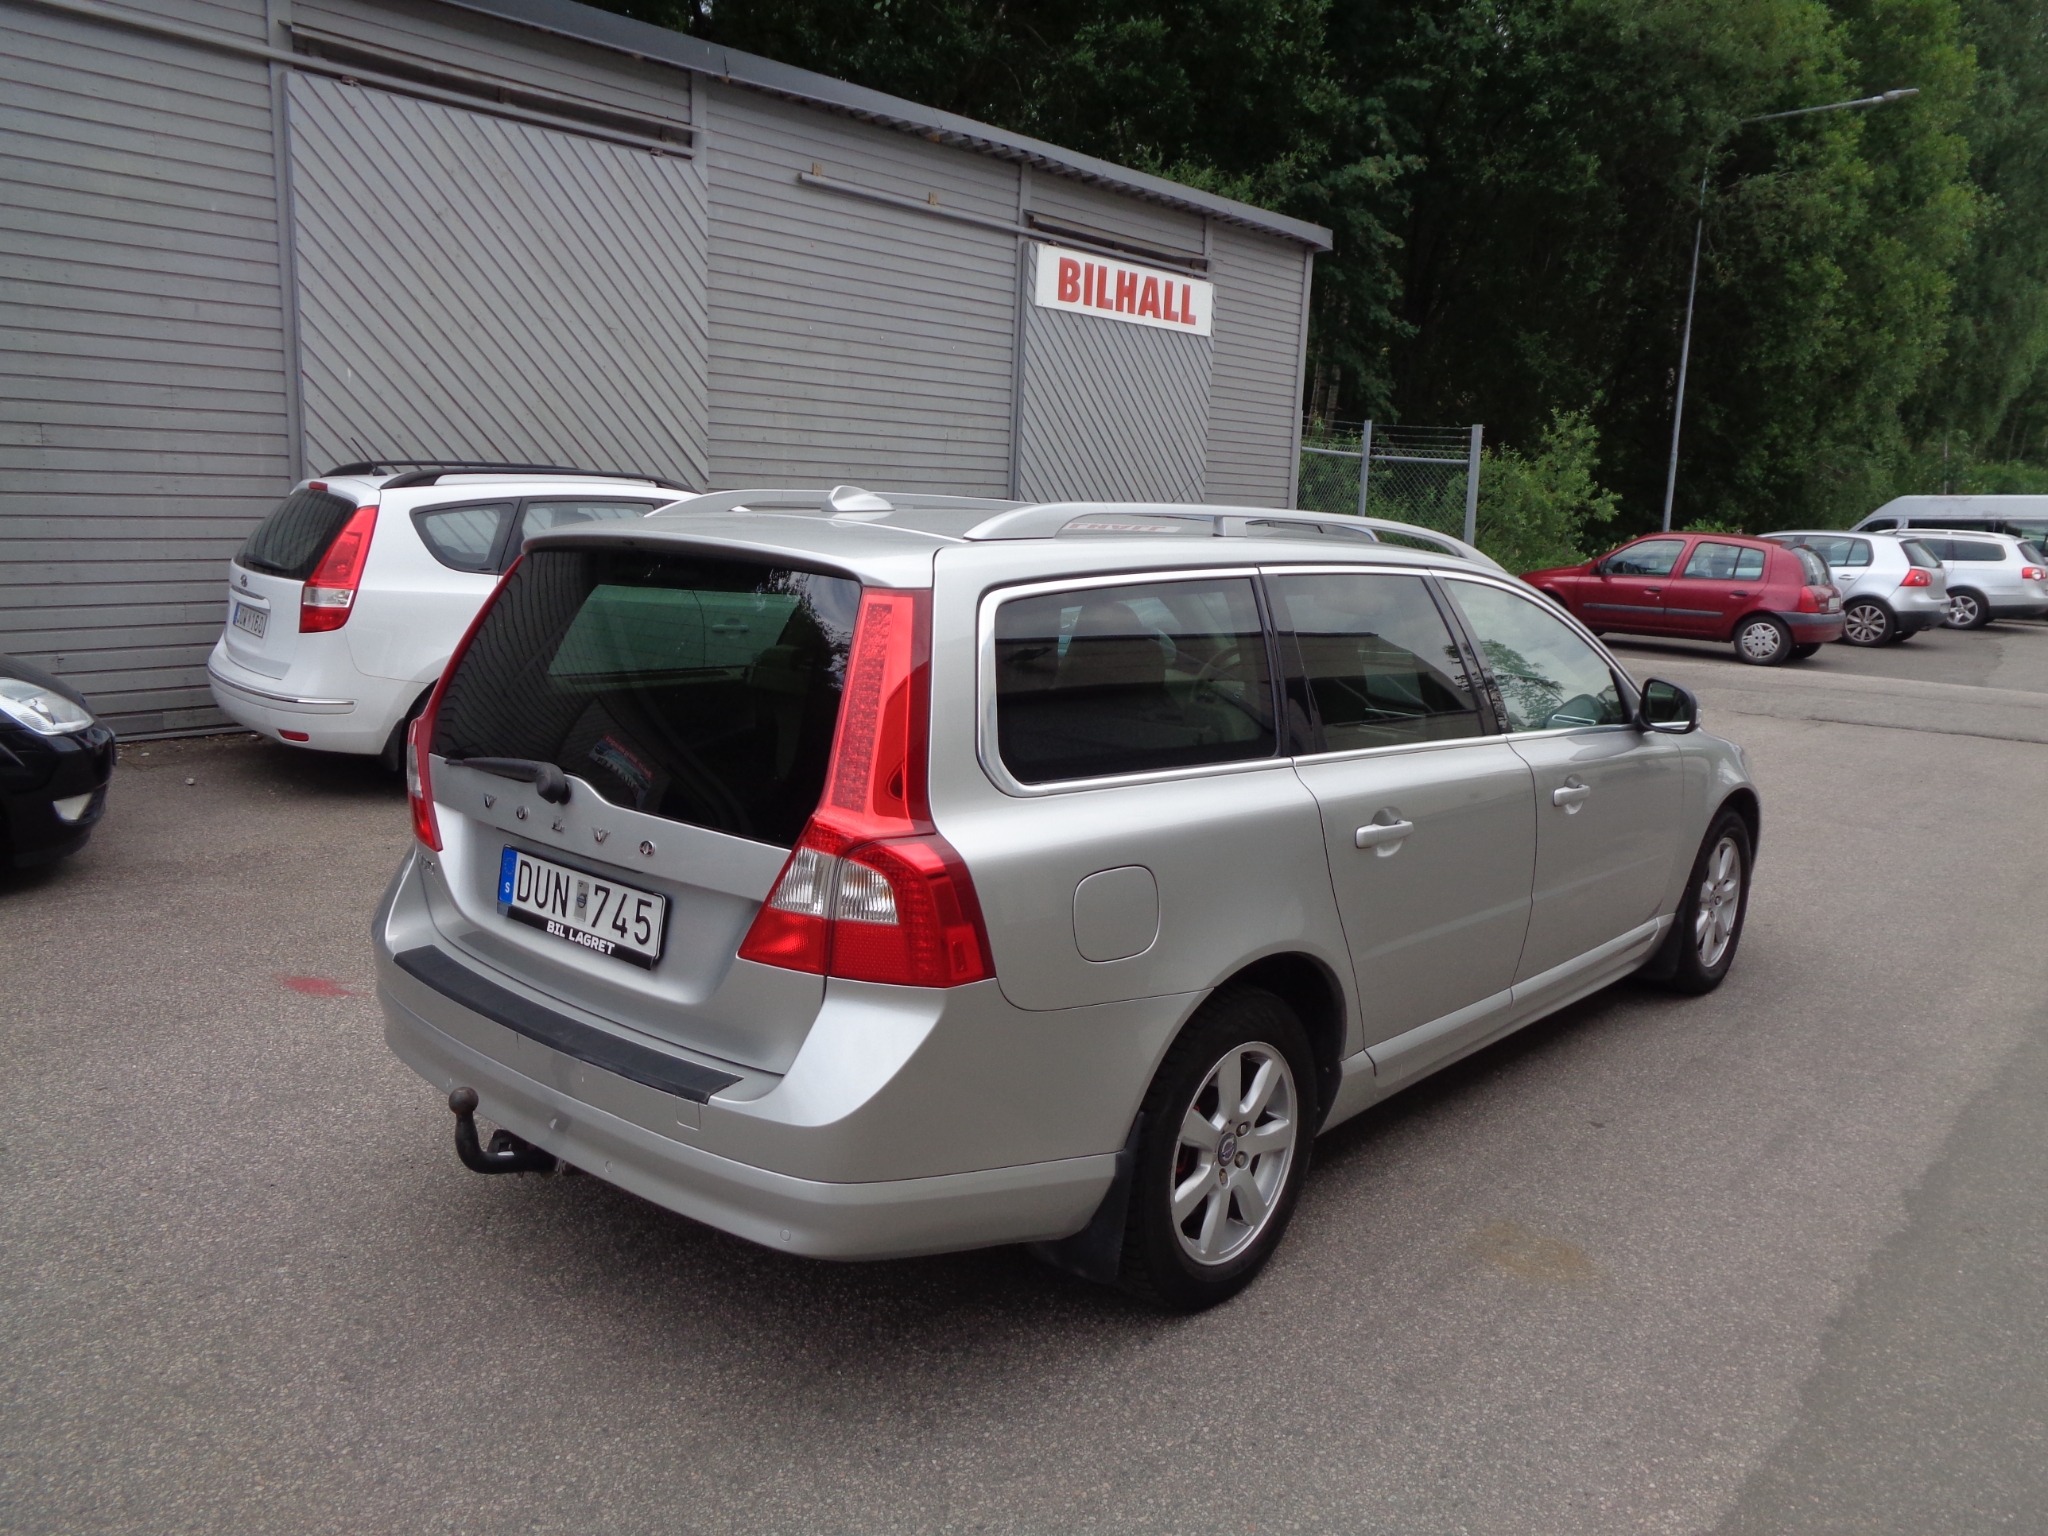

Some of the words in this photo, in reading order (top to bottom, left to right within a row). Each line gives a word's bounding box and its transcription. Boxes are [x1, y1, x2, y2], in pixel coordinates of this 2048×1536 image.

[1058, 257, 1197, 325] BILHALL
[484, 793, 656, 856] VOLVO
[505, 882, 511, 893] S
[516, 859, 570, 918] DUN
[591, 884, 653, 945] 745
[546, 920, 566, 938] BIL
[568, 931, 616, 955] LAGRET
